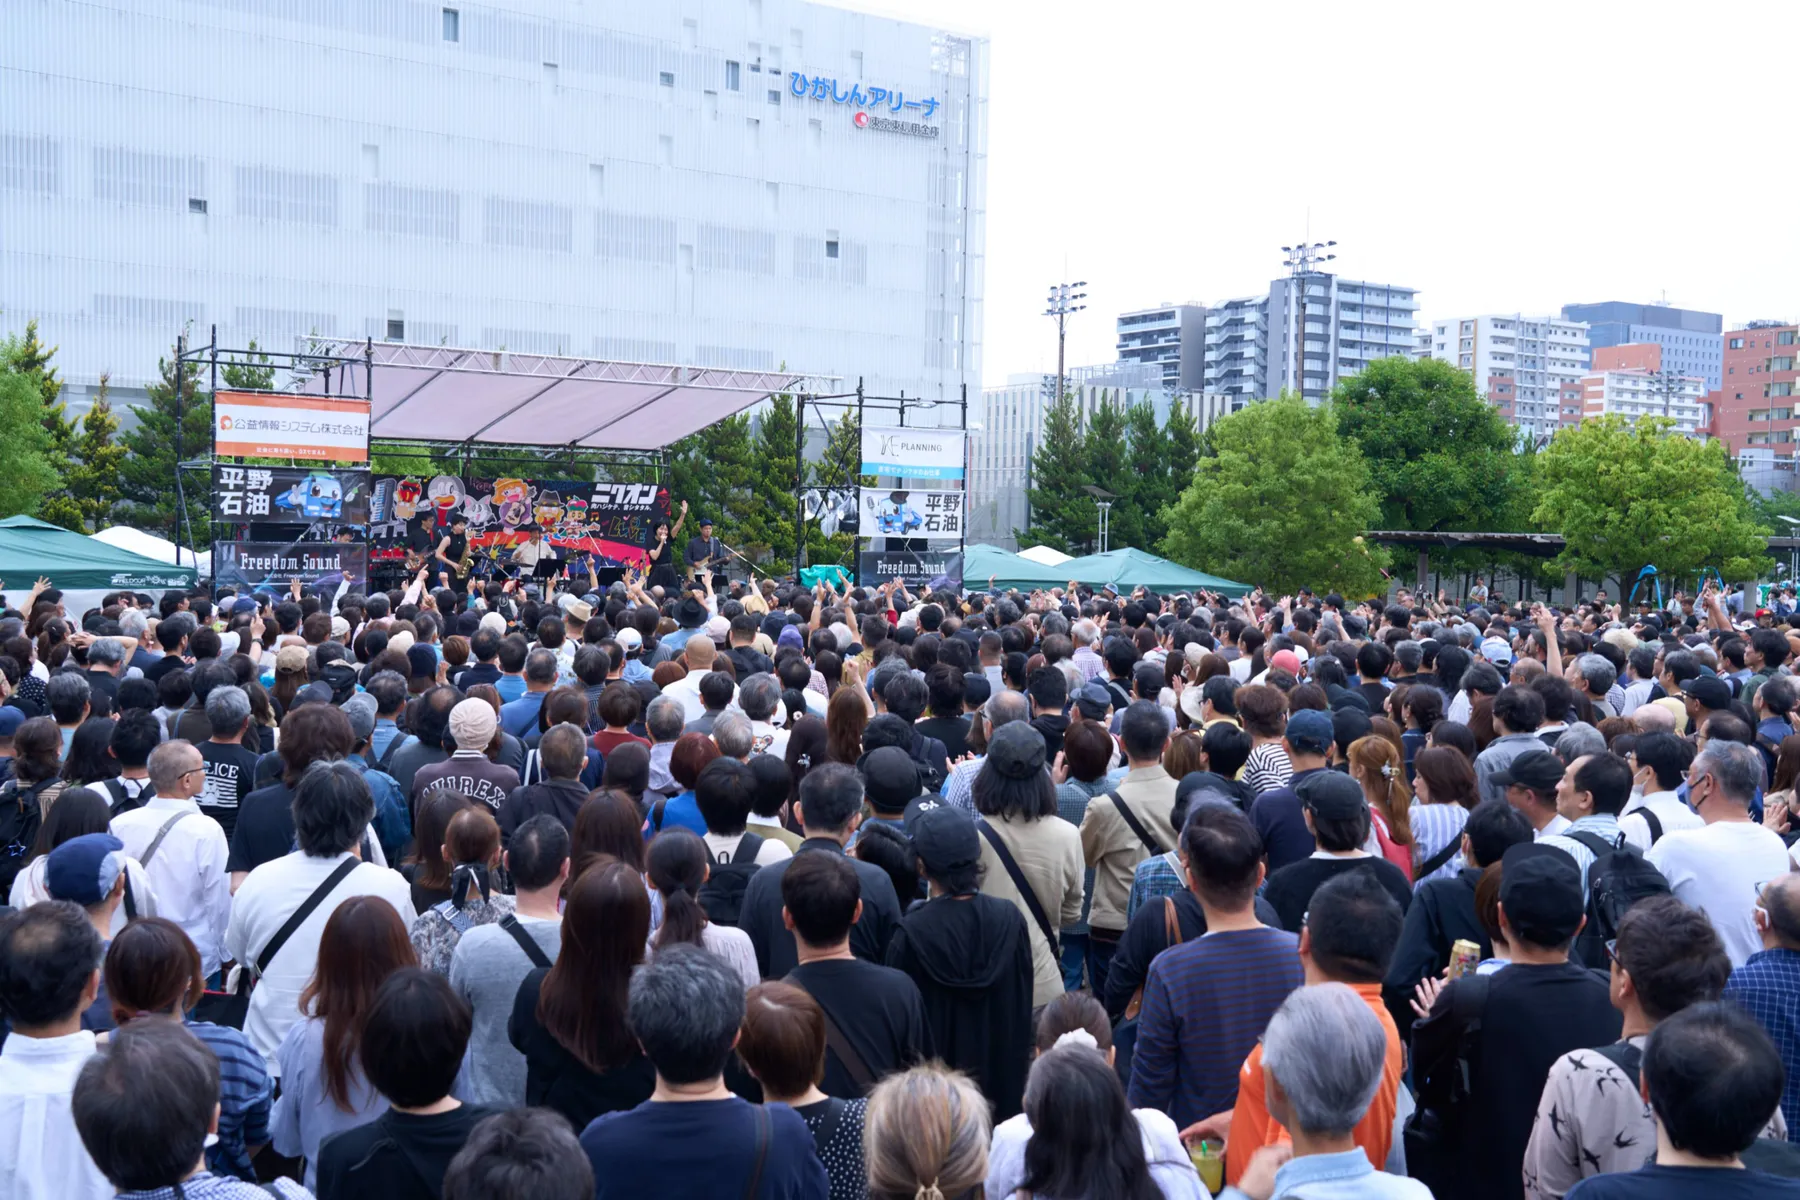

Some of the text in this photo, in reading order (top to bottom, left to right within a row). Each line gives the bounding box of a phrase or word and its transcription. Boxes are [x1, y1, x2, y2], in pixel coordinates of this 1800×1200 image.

[790, 71, 940, 117] ひがしんアリーナ
[234, 418, 364, 436] 公益情報システム株式会社
[901, 443, 942, 452] PLANNING
[219, 467, 273, 490] 平野
[591, 483, 658, 504] ニクオン
[219, 491, 270, 515] 石油
[925, 494, 960, 512] 平野
[924, 514, 959, 532] 石油
[240, 552, 342, 570] Freedom Sound
[876, 560, 946, 574] Freedom Sound
[204, 762, 239, 779] LICE
